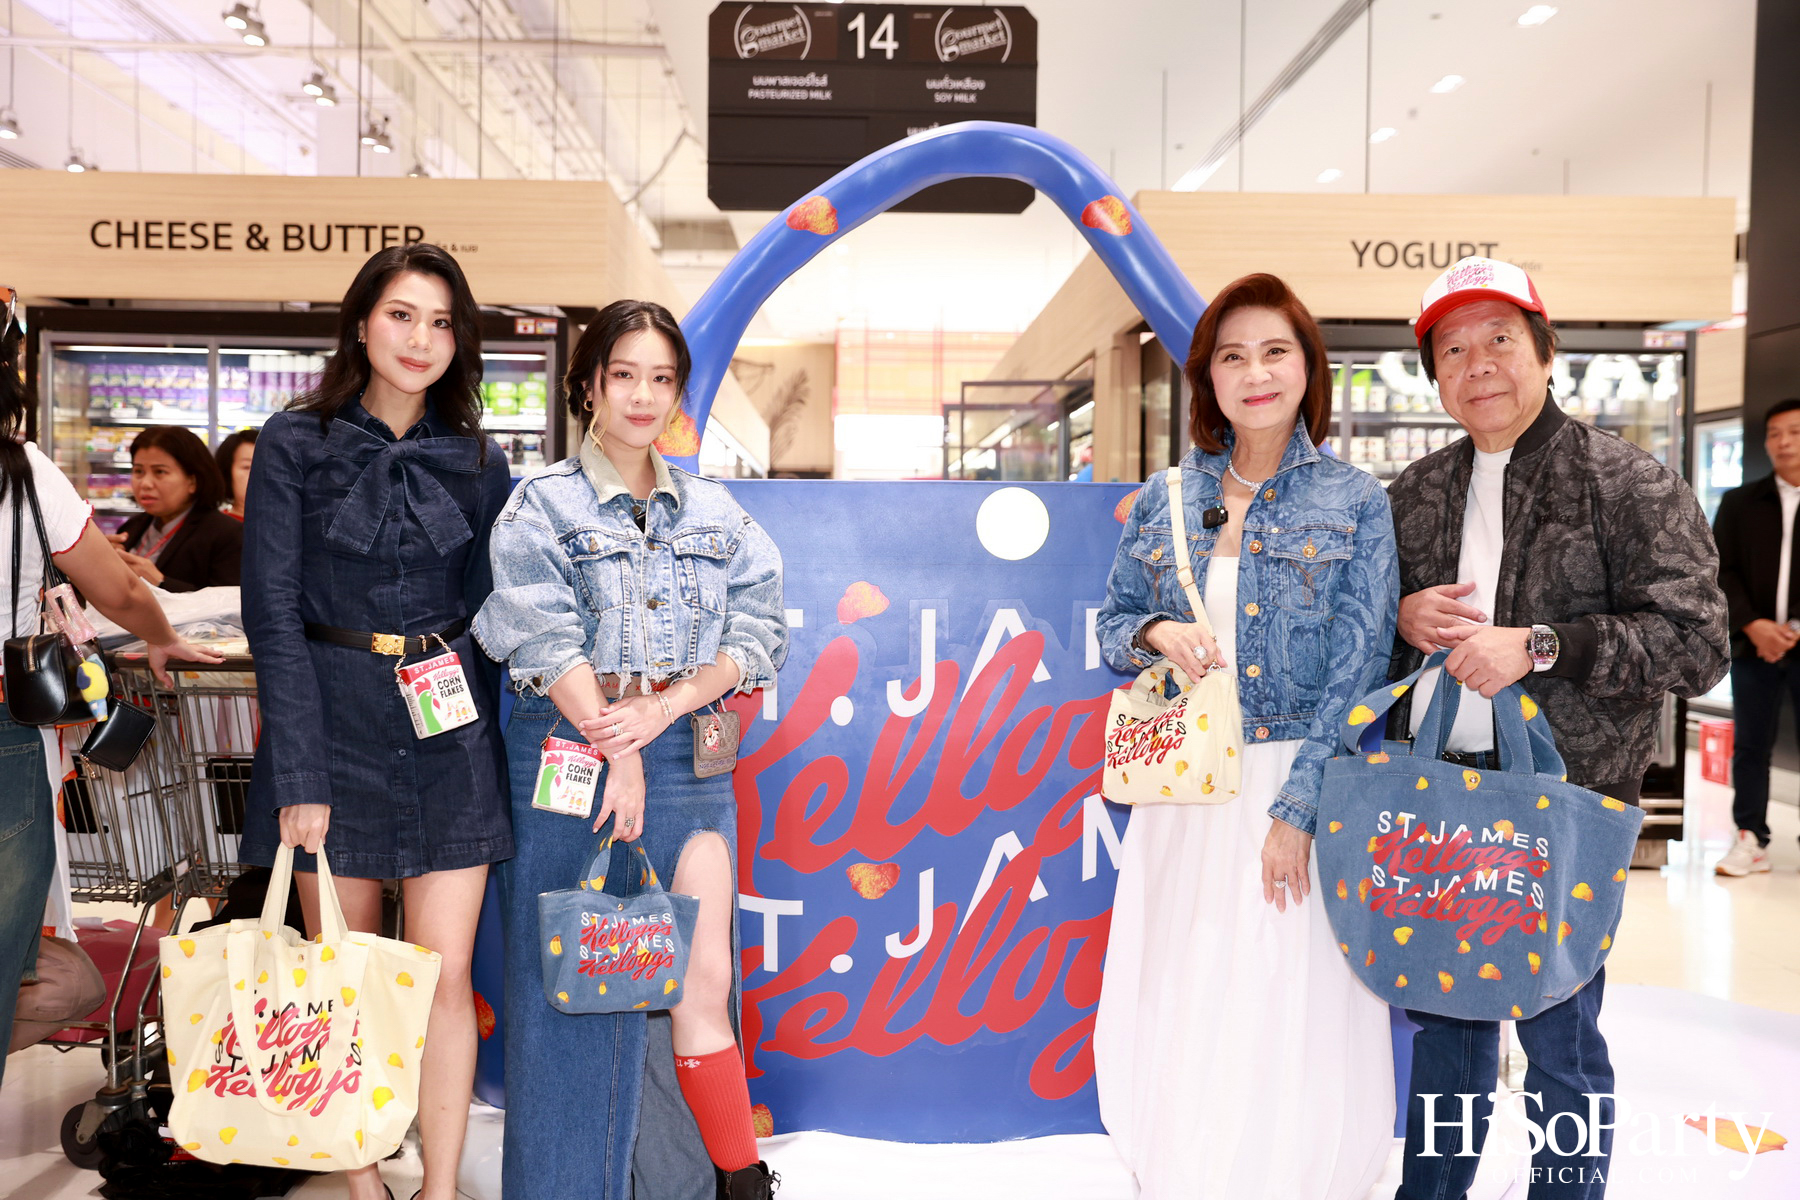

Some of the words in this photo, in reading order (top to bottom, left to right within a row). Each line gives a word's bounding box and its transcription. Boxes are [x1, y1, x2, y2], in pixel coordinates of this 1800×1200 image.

[847, 12, 899, 60] 14
[748, 89, 808, 100] PASTEURIZED
[809, 90, 832, 101] MILK
[934, 92, 953, 103] SOY
[954, 93, 977, 103] MILK
[91, 220, 233, 249] CHEESE
[245, 223, 270, 251] &
[283, 224, 425, 252] BUTTER
[1351, 240, 1499, 269] YOGURT
[413, 655, 456, 675] ST.JAMES
[437, 674, 462, 690] CORN
[439, 684, 465, 699] FLAKES
[555, 741, 599, 757] ST.JAMES
[567, 763, 594, 777] CORN
[565, 772, 592, 786] FLAKES
